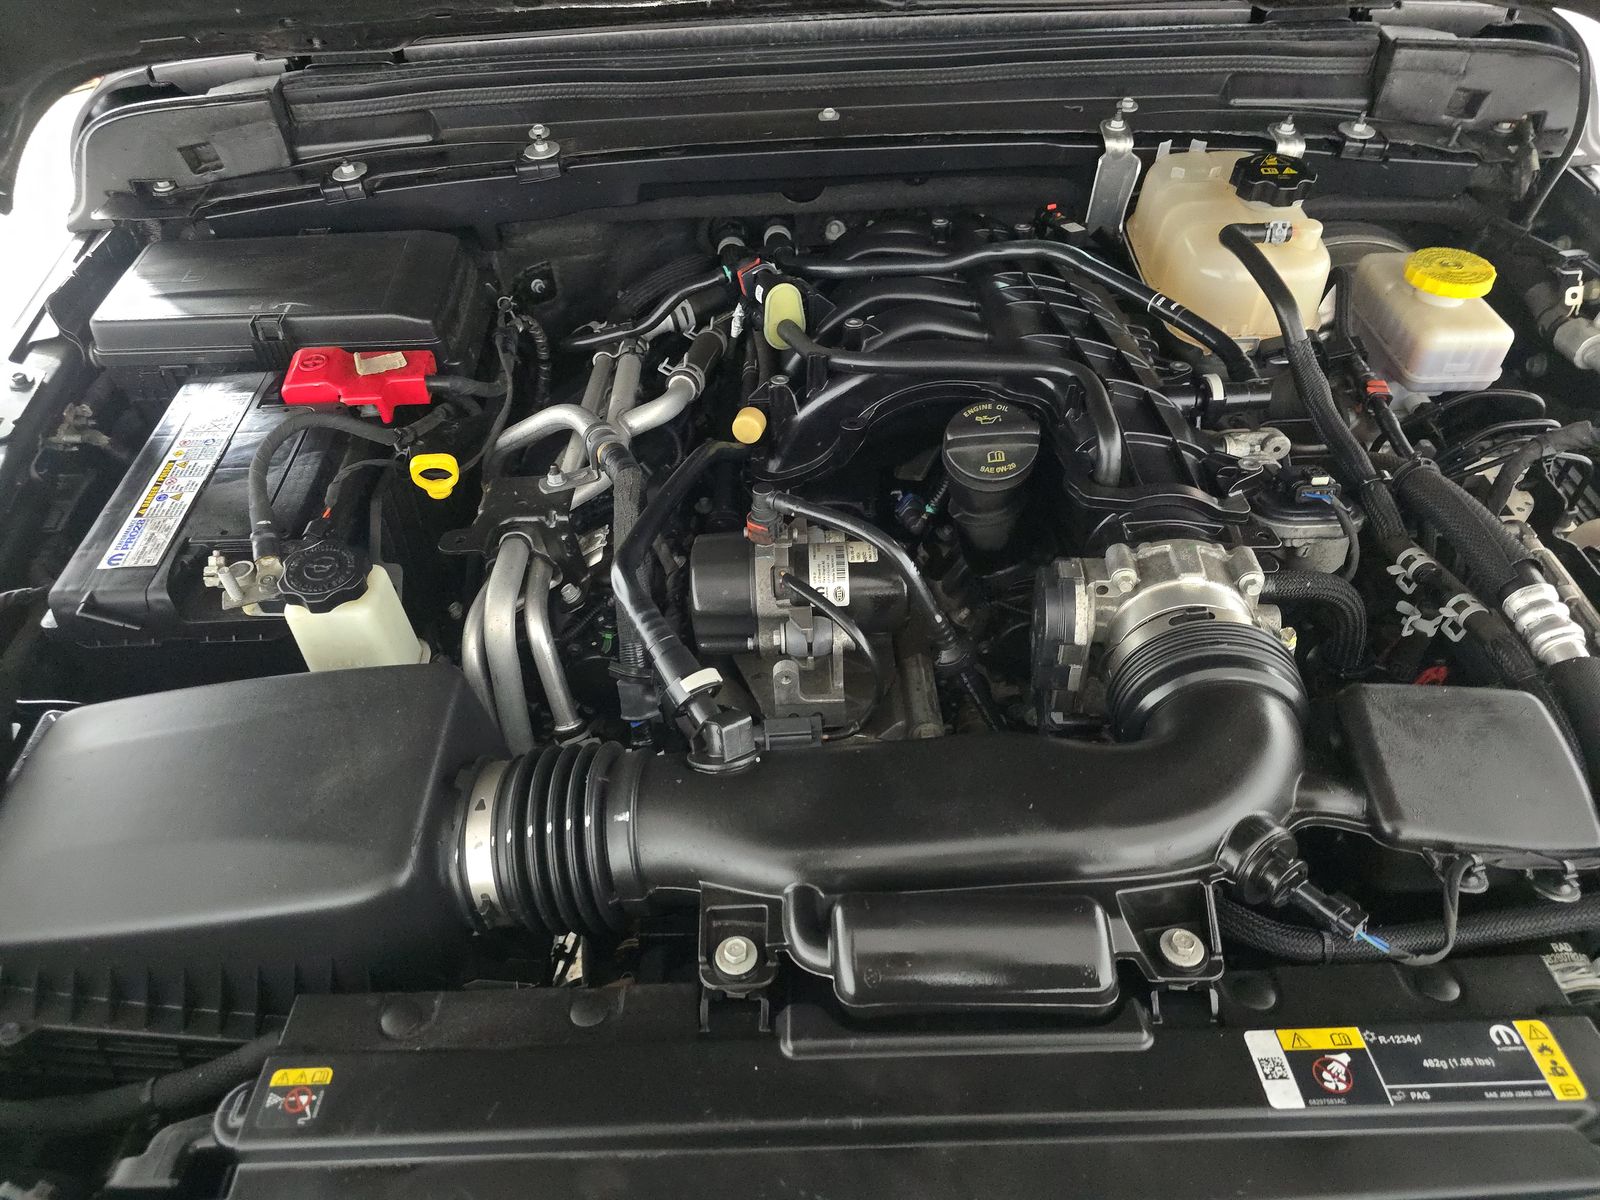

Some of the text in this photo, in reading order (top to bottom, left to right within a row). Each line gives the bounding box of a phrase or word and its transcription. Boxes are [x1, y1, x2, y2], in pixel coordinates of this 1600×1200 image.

[963, 403, 1009, 418] ENGINE OIL
[979, 462, 1017, 473] SAE 0W-20
[120, 518, 146, 550] PRO28
[1550, 942, 1573, 953] RAD
[1378, 1034, 1422, 1045] R-1234yf
[1422, 1056, 1495, 1069] 482g (1.06 lbs)
[1410, 1091, 1431, 1101] PAG
